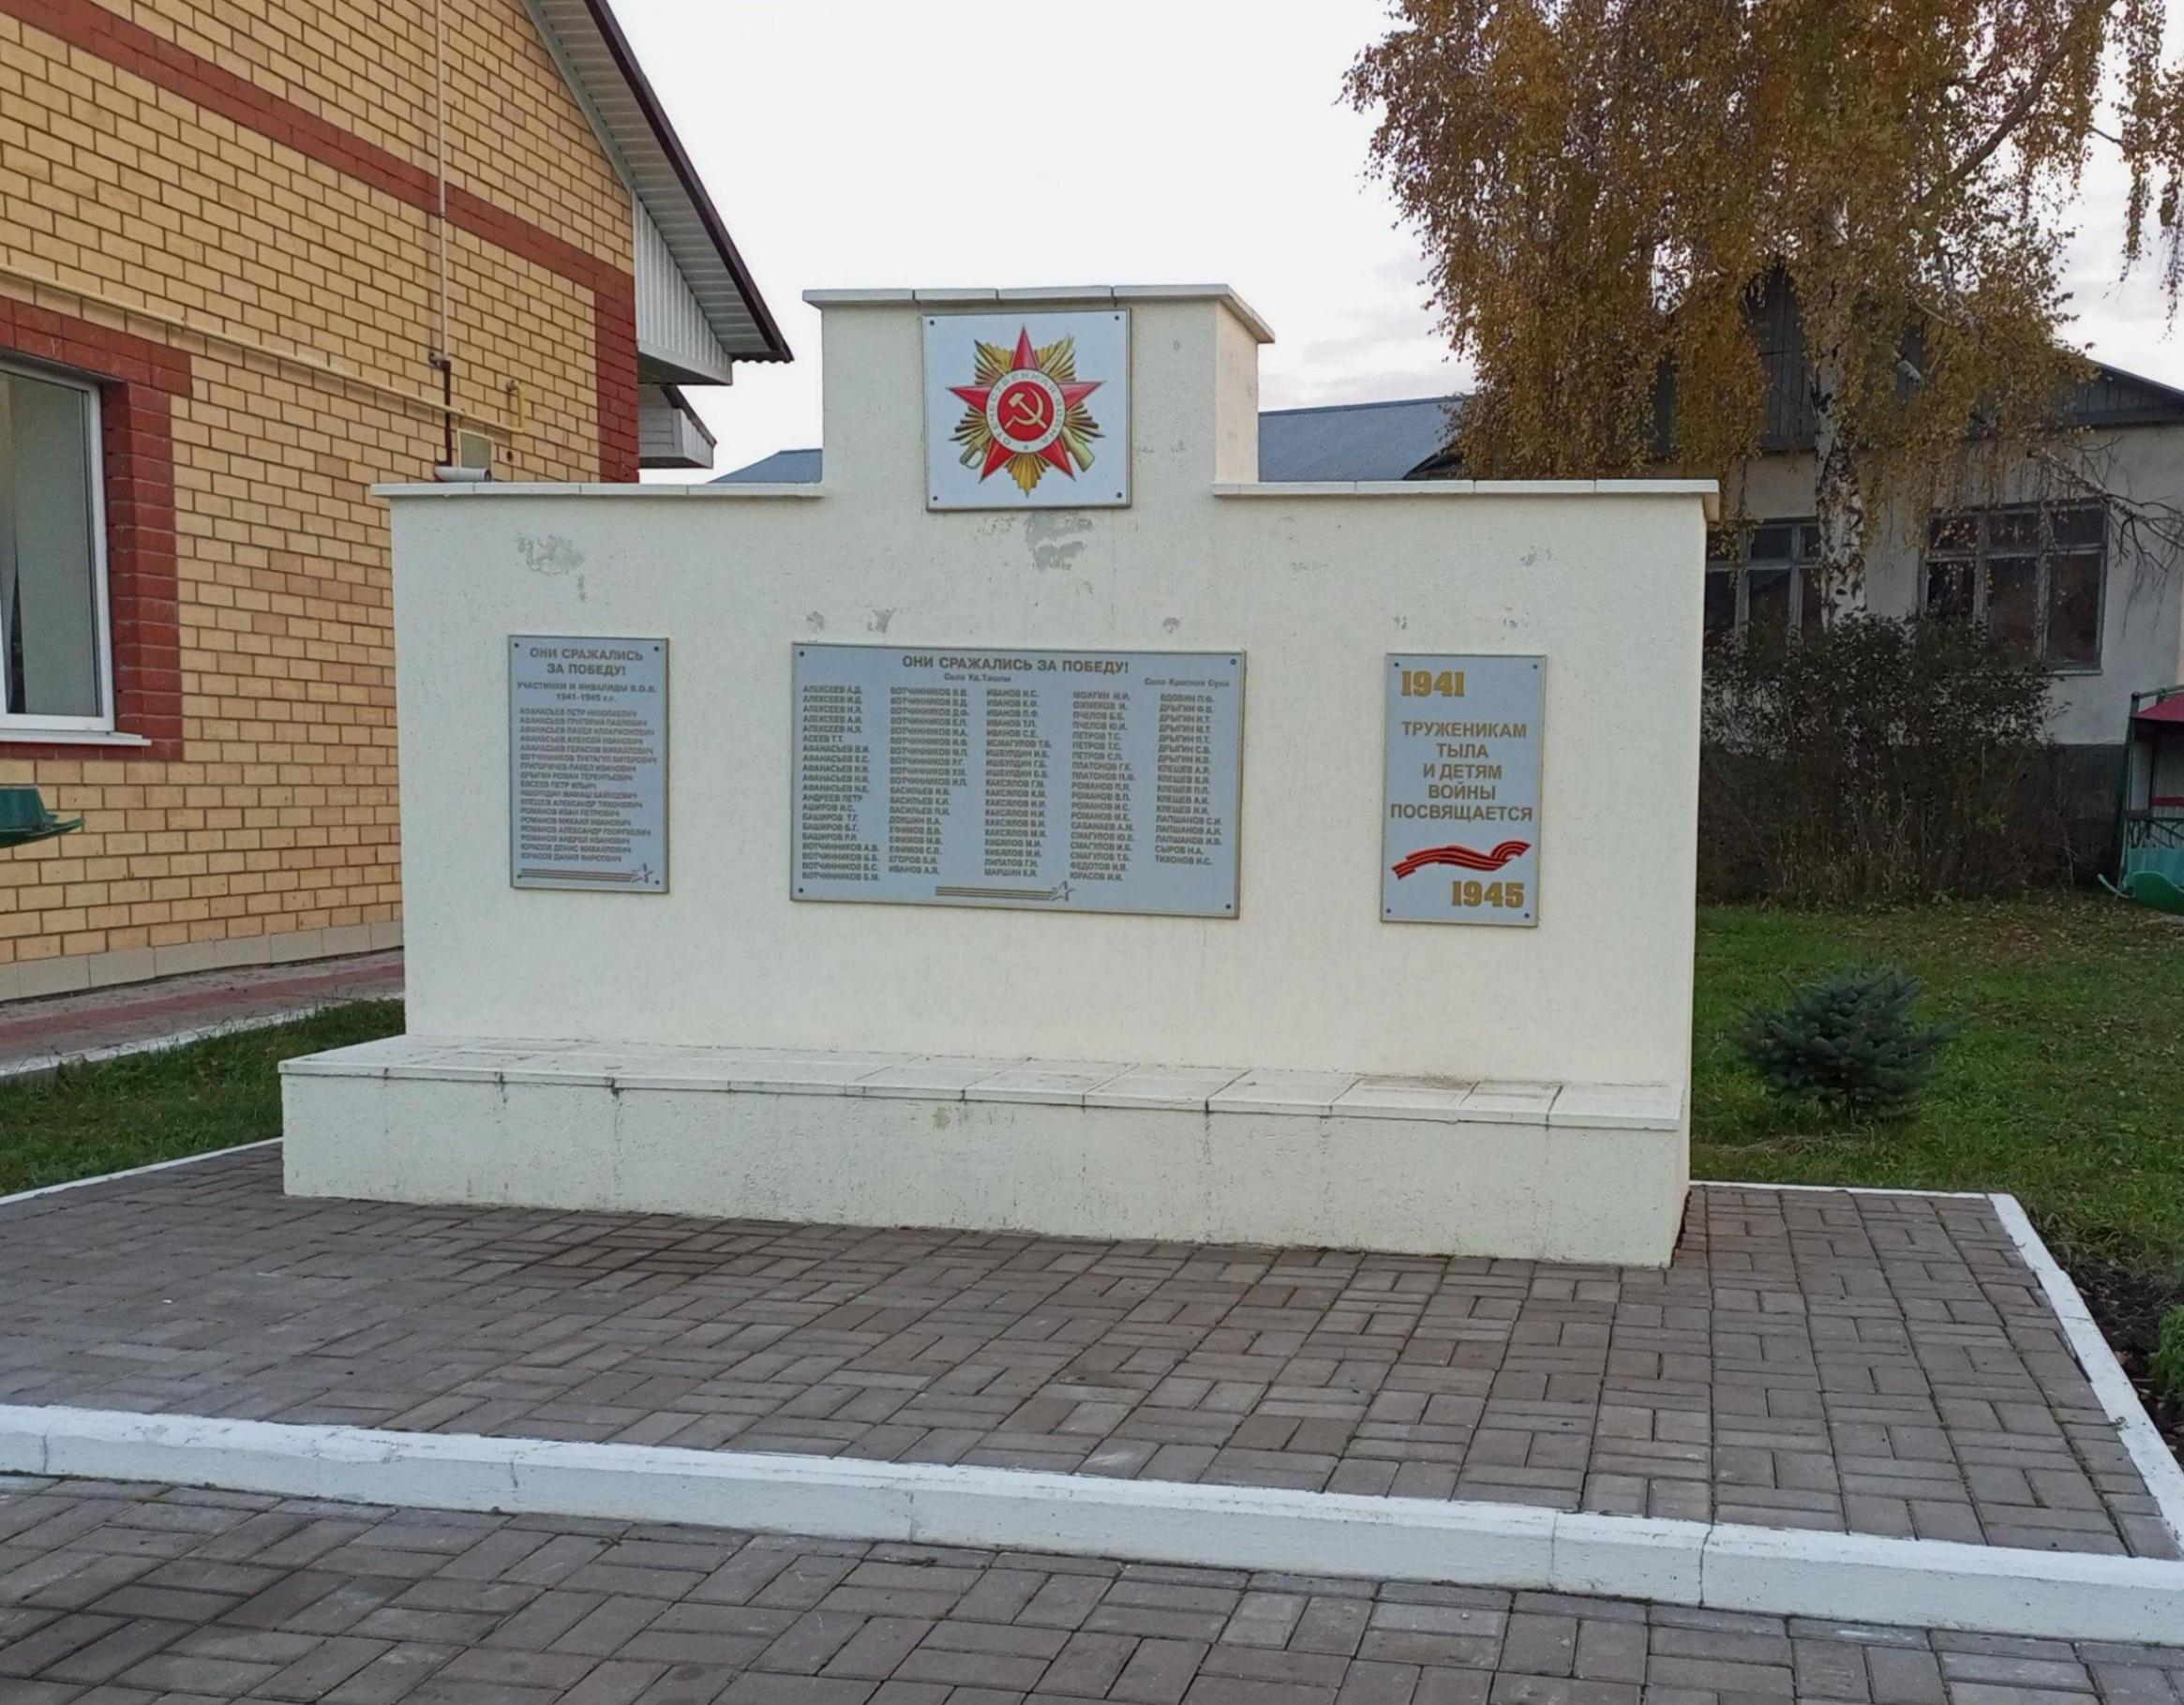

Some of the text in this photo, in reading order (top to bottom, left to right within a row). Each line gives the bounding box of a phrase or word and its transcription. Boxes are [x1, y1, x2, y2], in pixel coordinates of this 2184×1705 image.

[531, 648, 643, 661] ОНИ СРАЖАЛИСЬ
[547, 664, 625, 677] ЗА ПОБЕДУ!
[903, 656, 1129, 675] ОНИ СРАЖАЛИСЬ ЗА ПОБЕДУ!
[517, 681, 566, 690] УЧАСТНИКИ
[578, 683, 627, 692] ИНВАЛИДЫ
[1401, 670, 1465, 697] 1941
[1401, 721, 1528, 738] ТРУЖЕНИКАМ
[1436, 742, 1488, 758] ТЫЛА
[1423, 763, 1503, 781] И ДЕТЯМ
[1428, 781, 1496, 800] ВОЙНЫ
[1390, 803, 1533, 823] ПОСВЯЩАЕТСЯ
[1451, 880, 1525, 909] 1945
